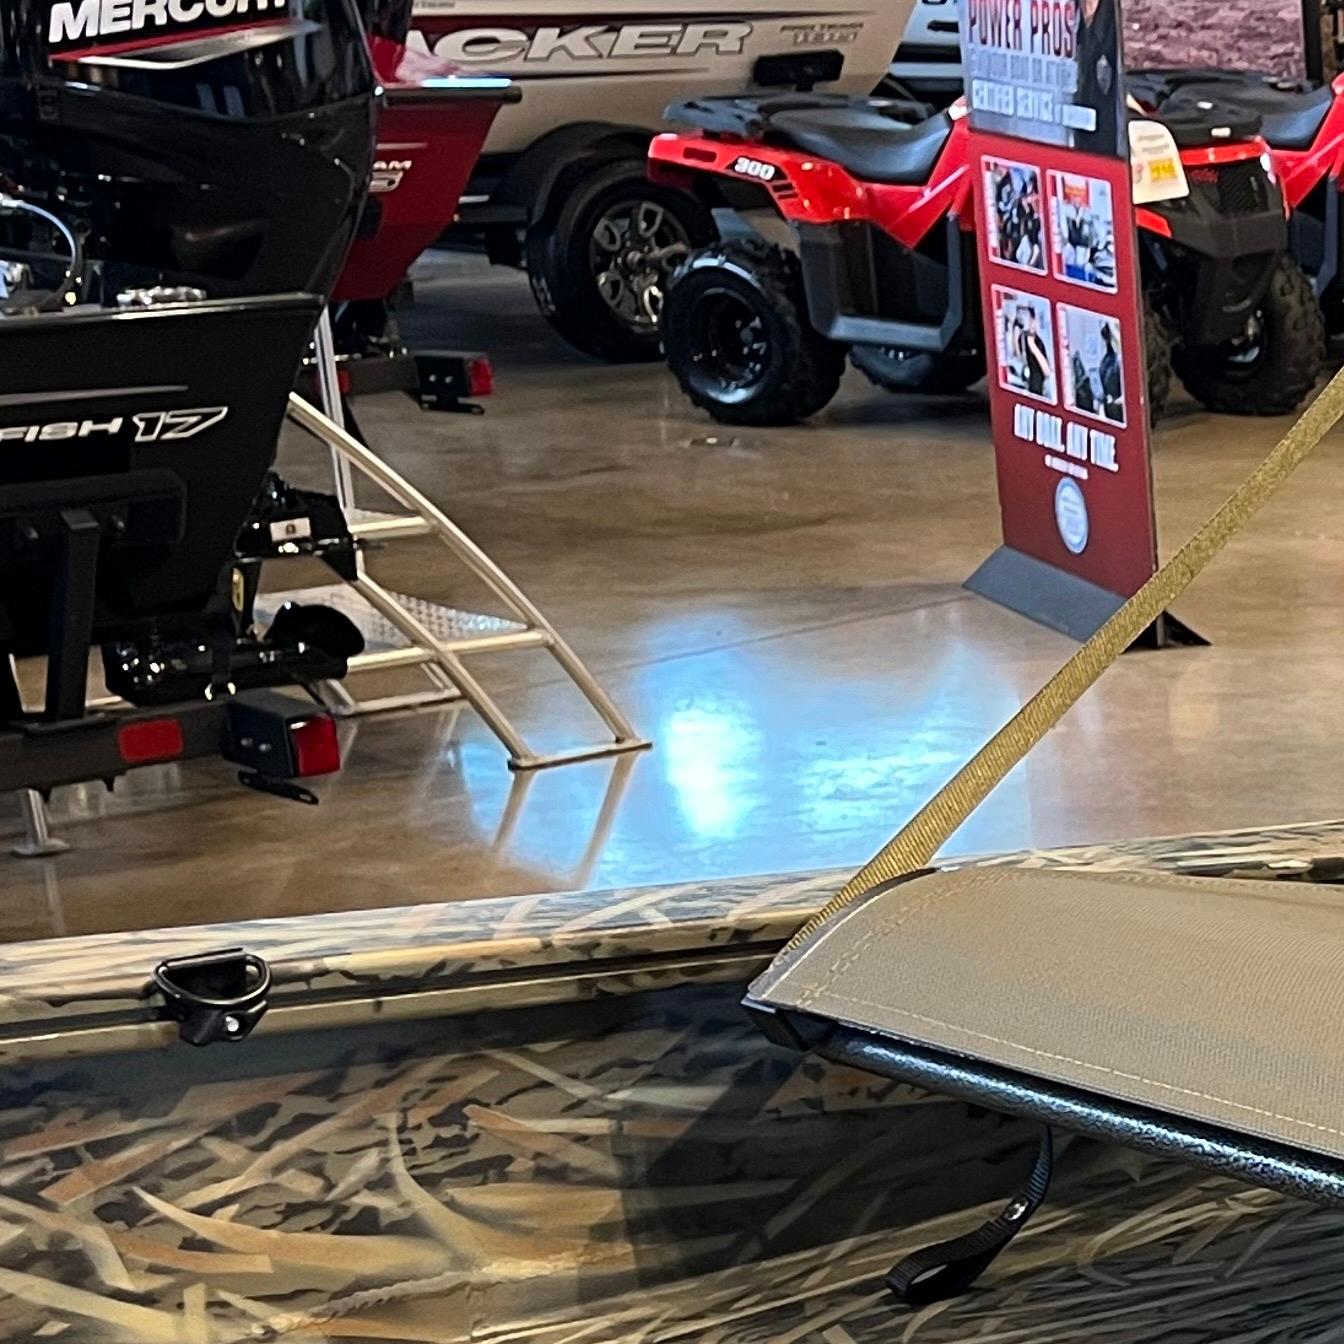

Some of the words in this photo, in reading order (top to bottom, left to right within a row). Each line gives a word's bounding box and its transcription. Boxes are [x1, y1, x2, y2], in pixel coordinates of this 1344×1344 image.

[1031, 0, 1076, 58] PROS
[734, 156, 776, 180] 300
[131, 405, 229, 443] 17
